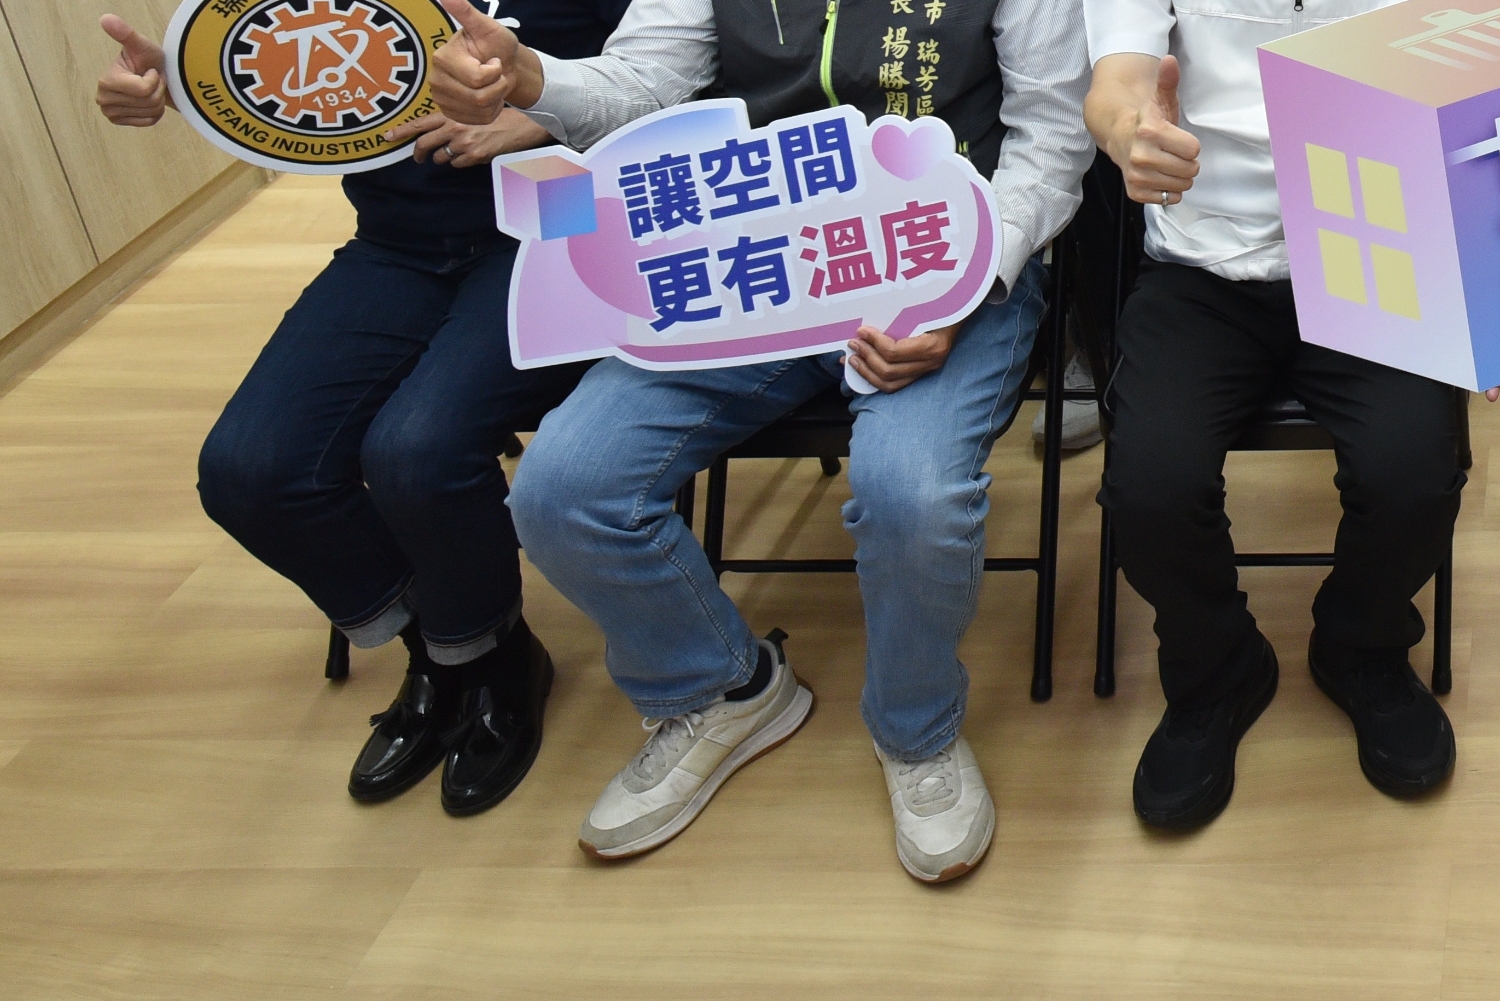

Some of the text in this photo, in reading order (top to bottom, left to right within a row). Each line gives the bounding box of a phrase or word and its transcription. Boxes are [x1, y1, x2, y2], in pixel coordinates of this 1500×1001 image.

[312, 87, 368, 111] 1934
[915, 39, 942, 117] 瑞芳區
[197, 80, 271, 143] JUI-FANG
[271, 131, 388, 156] INDUSTRIA
[618, 117, 860, 240] 讓空間
[637, 200, 958, 333] 更有溫度
